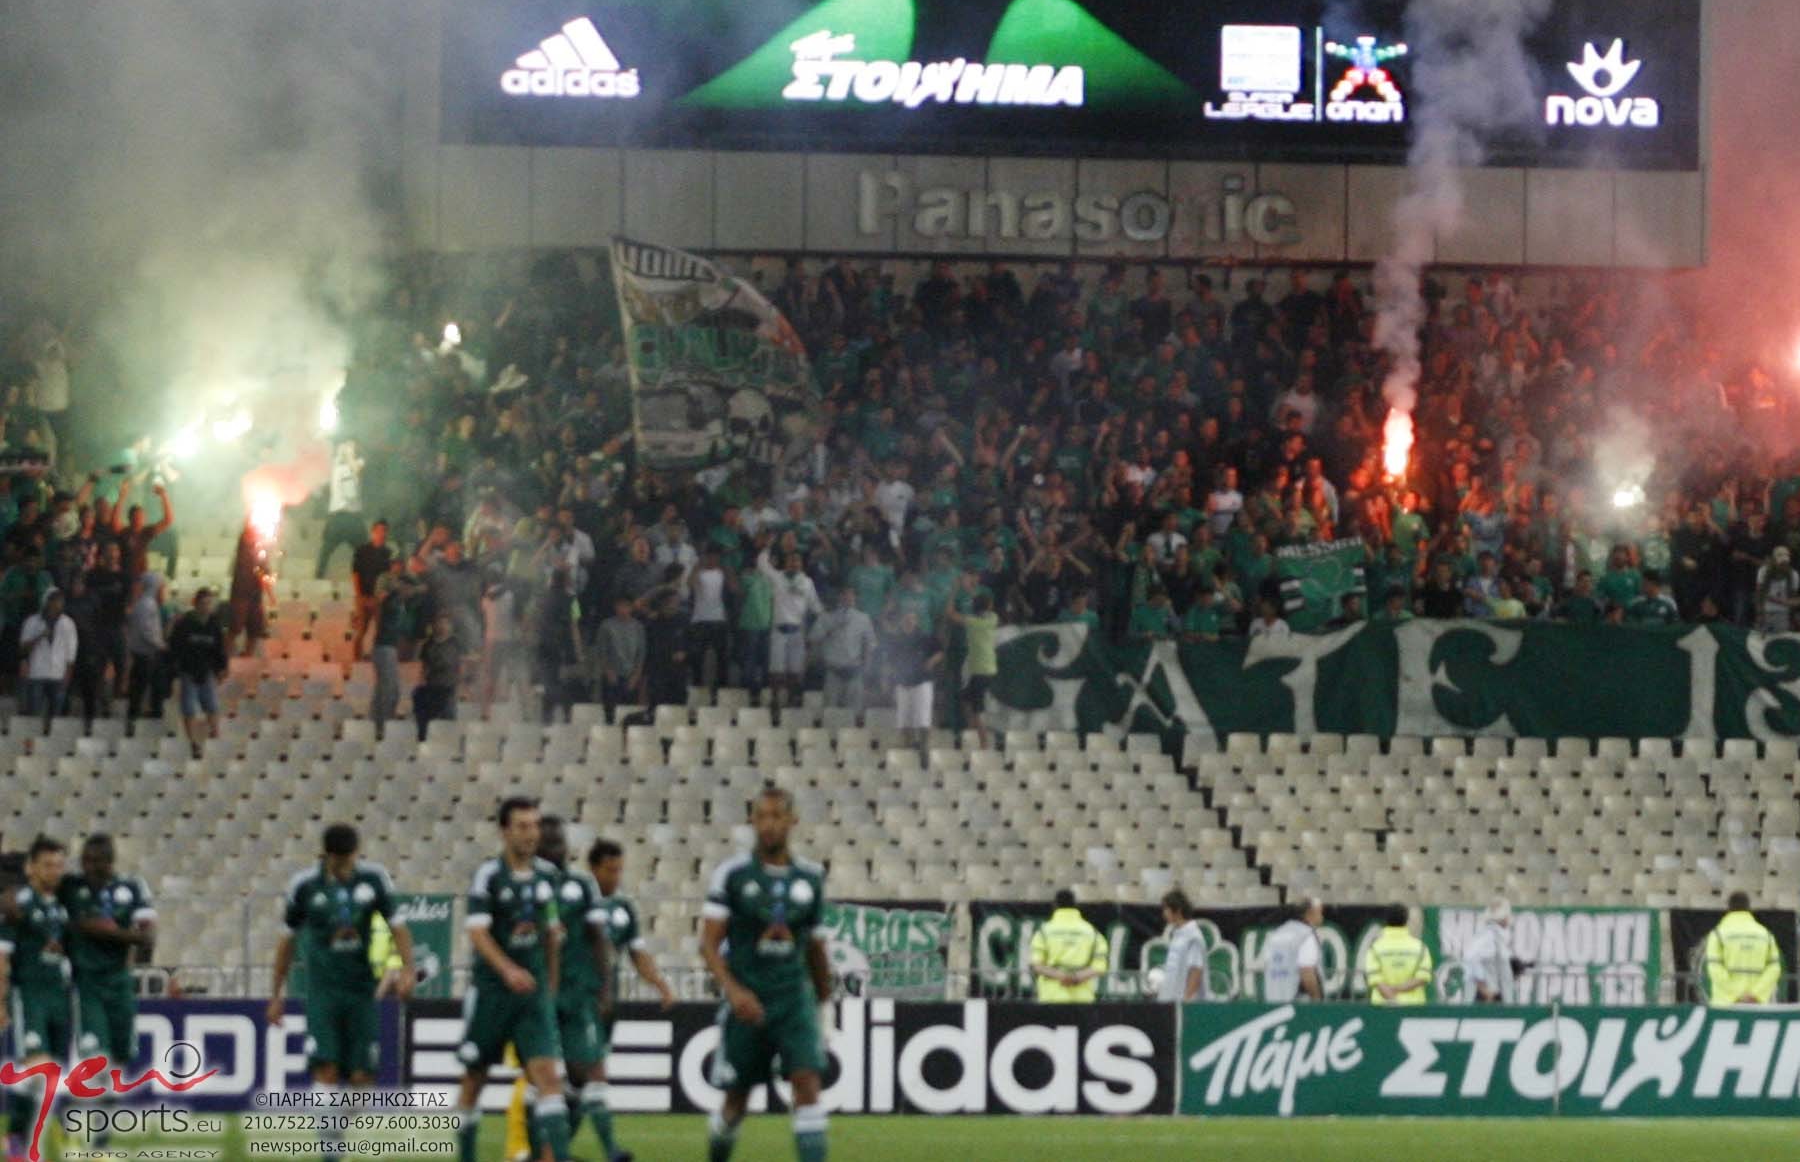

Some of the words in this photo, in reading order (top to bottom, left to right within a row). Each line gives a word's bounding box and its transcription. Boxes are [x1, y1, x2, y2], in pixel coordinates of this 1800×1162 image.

[499, 67, 641, 99] adidas
[1545, 95, 1660, 128] nova
[857, 168, 1300, 245] Panasoic
[962, 619, 1525, 764] GATE
